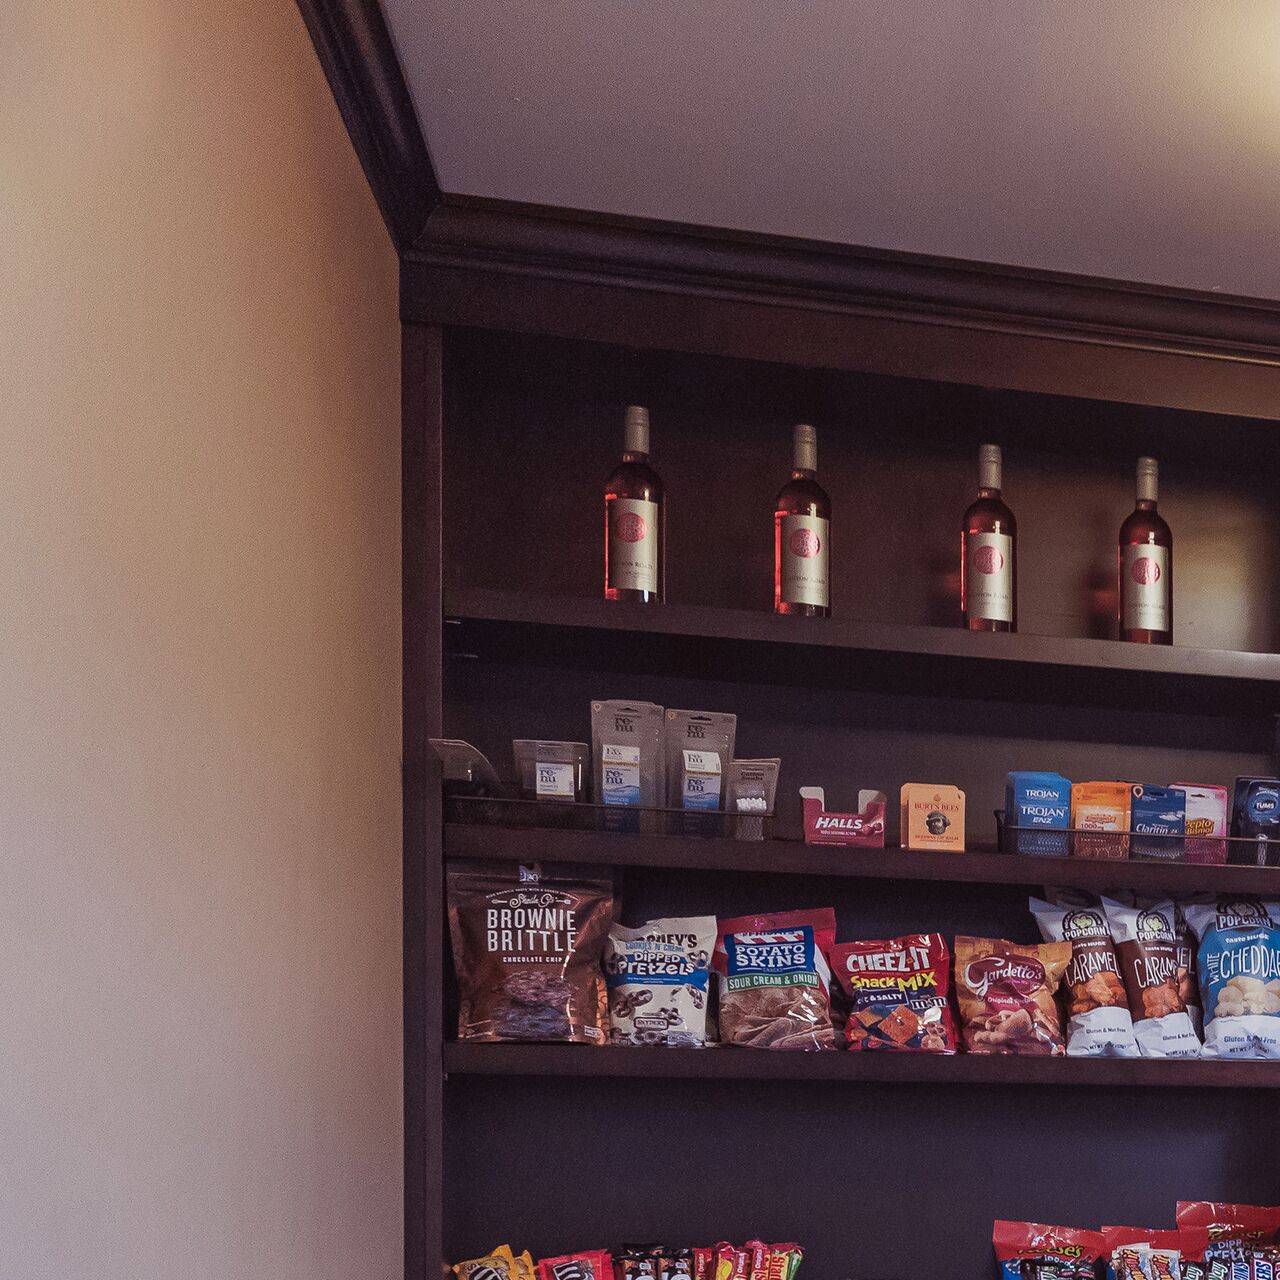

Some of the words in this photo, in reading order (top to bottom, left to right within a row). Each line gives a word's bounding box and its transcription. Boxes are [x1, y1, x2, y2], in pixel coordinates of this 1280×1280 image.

[1025, 789, 1060, 799] TROJAN
[1021, 805, 1066, 818] TROJAN
[1255, 802, 1275, 810] TUMS
[814, 816, 863, 829] HALLS
[1136, 822, 1169, 835] Claritin
[487, 908, 577, 931] BROWNIE
[1218, 914, 1272, 929] POPCORN
[1065, 927, 1109, 941] POPCORN
[1139, 931, 1175, 942] POPCORN
[487, 930, 577, 953] BRITTLE
[735, 944, 806, 956] POTATO
[735, 953, 807, 968] SKINS
[1065, 951, 1123, 988] CARAMEL
[1207, 952, 1220, 986] WHITE
[729, 977, 751, 990] SOUR
[753, 976, 782, 987] CREAM
[784, 976, 790, 985] &
[793, 973, 818, 986] ONION
[850, 975, 898, 990] Snack
[965, 957, 1043, 1001] Gardetto's
[876, 993, 903, 1002] SALTY
